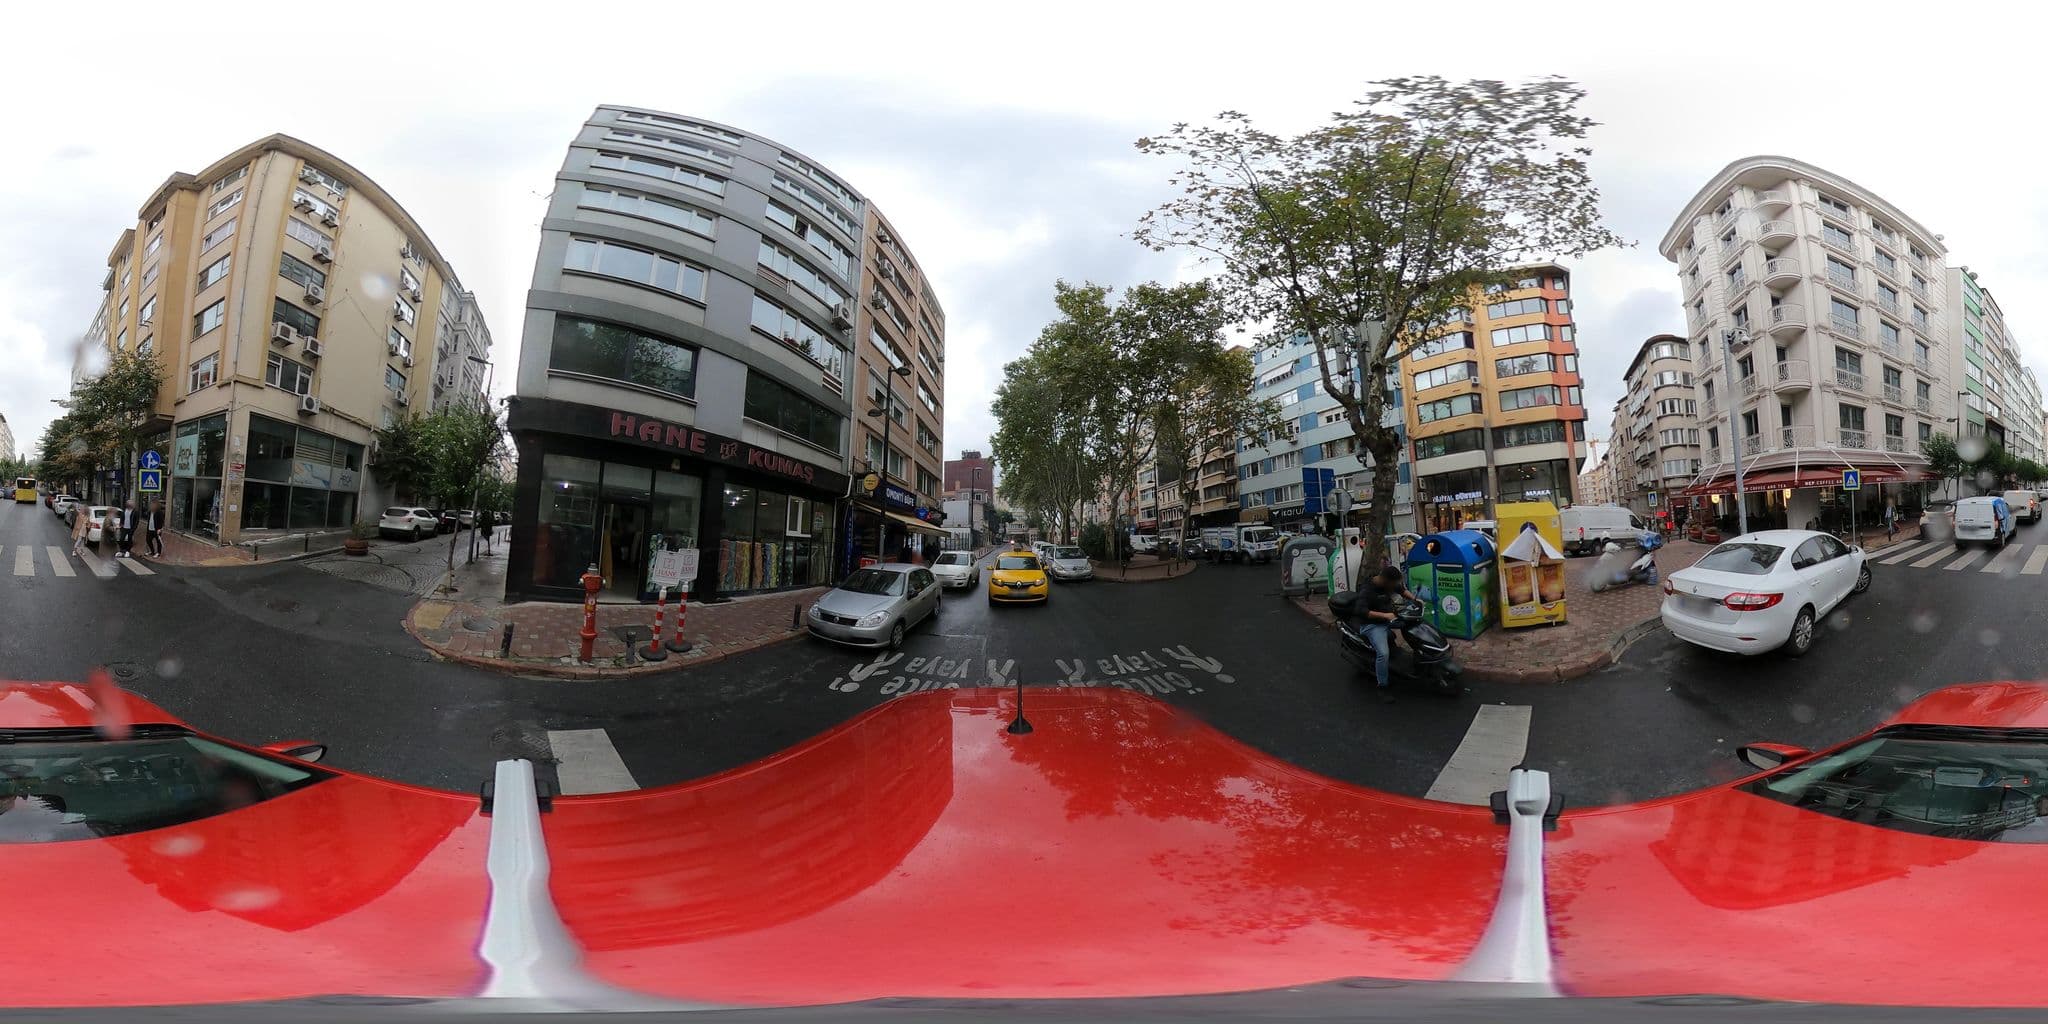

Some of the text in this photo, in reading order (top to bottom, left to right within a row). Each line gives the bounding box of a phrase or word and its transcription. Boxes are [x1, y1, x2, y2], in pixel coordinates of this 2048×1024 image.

[611, 412, 706, 454] HANE
[748, 448, 814, 484] KUMAŞ
[904, 656, 972, 679] yaya
[1096, 651, 1168, 676] yaya
